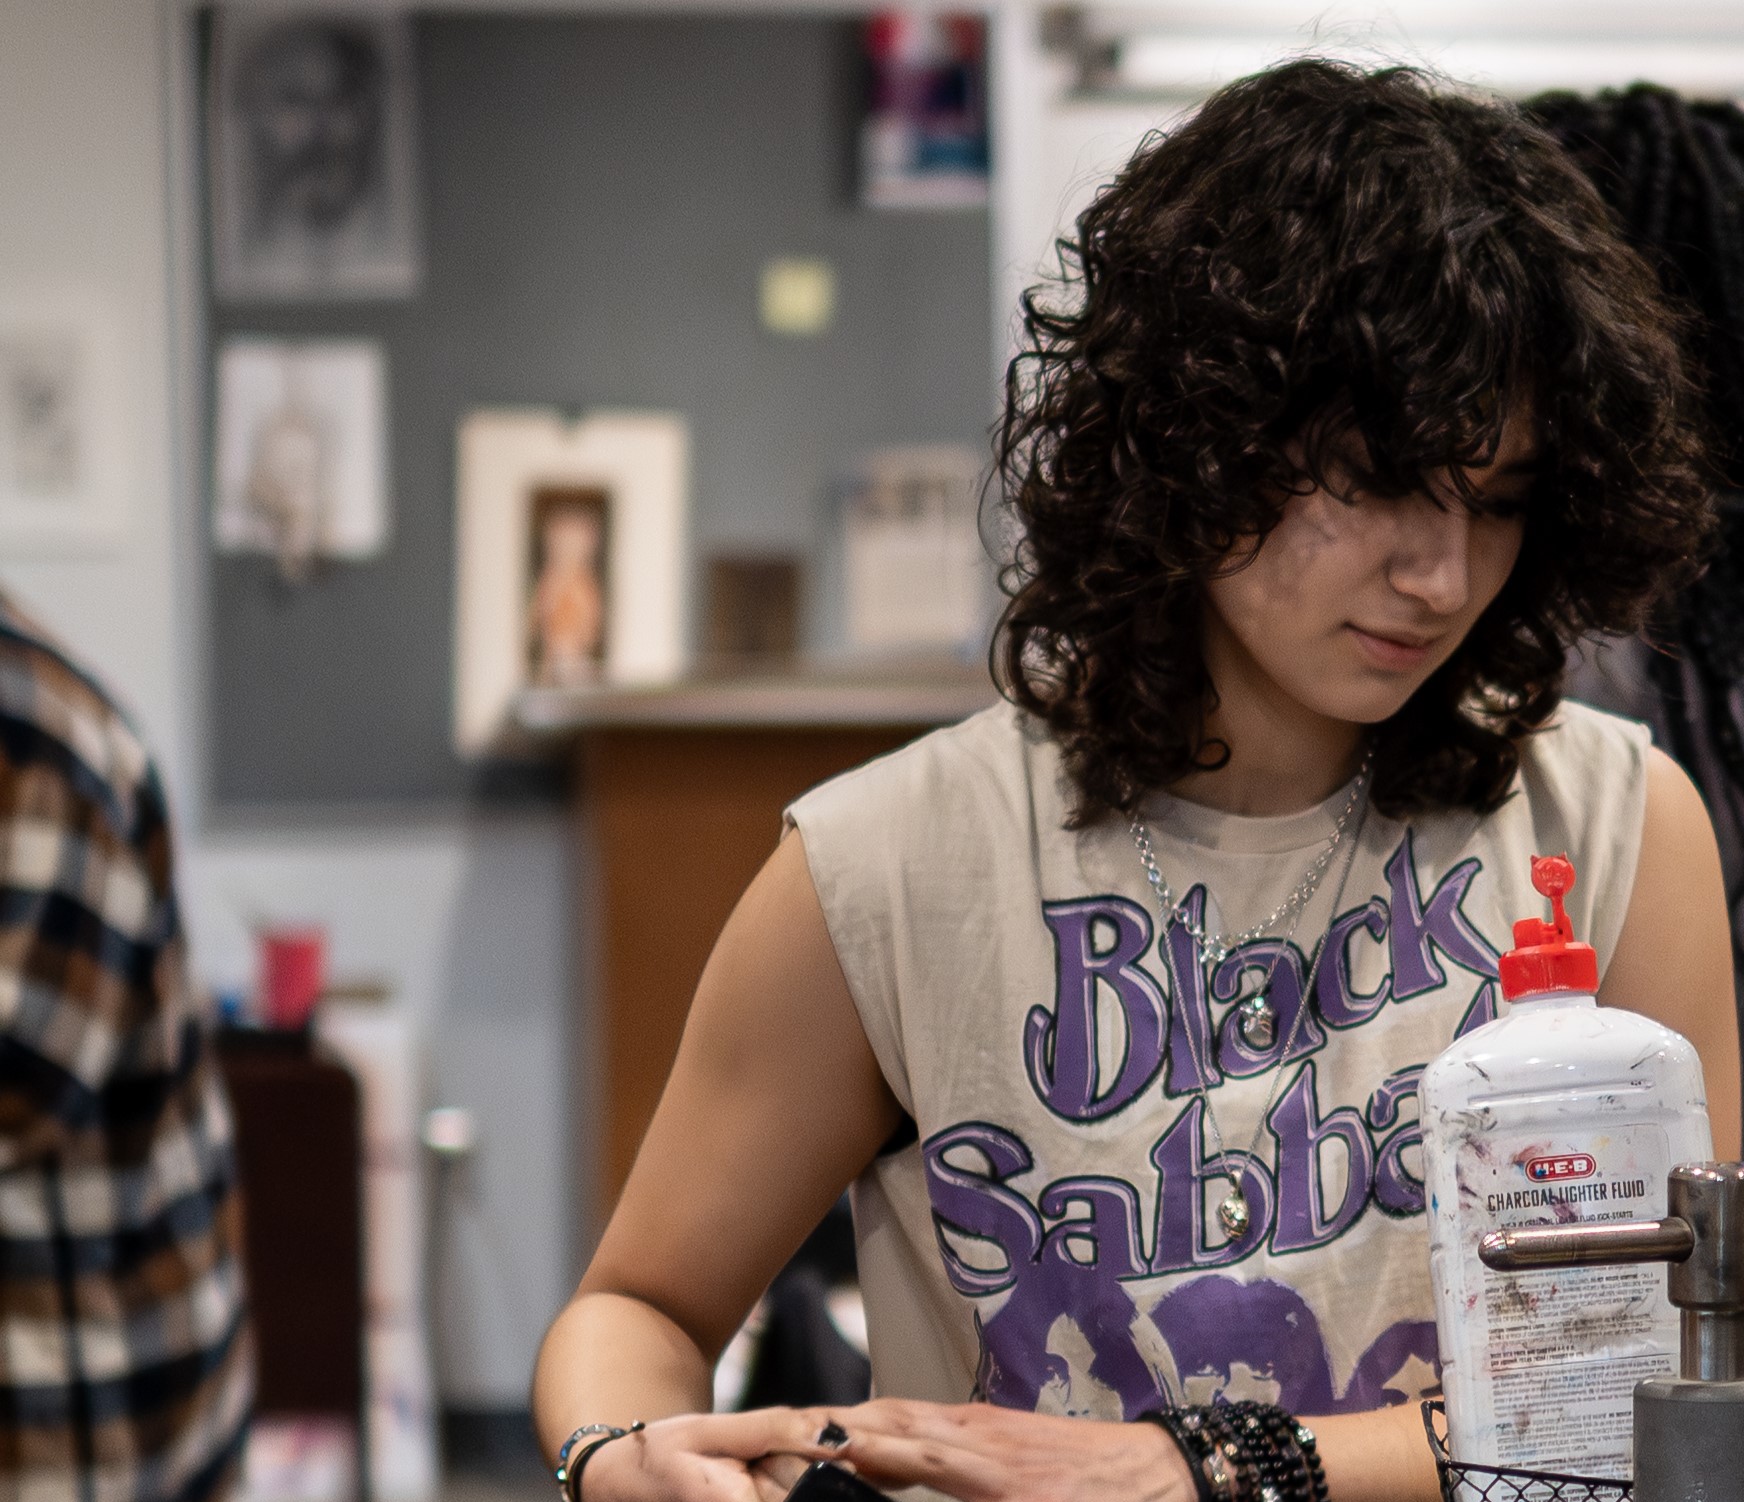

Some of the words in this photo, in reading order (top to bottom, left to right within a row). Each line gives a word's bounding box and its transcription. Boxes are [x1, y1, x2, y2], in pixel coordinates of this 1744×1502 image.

[1023, 826, 1501, 1126] Black
[921, 978, 1498, 1299] Sabba
[1487, 1186, 1556, 1212] CHARCOAL
[1558, 1182, 1608, 1206] LIGHTER
[1611, 1180, 1645, 1200] FLUID
